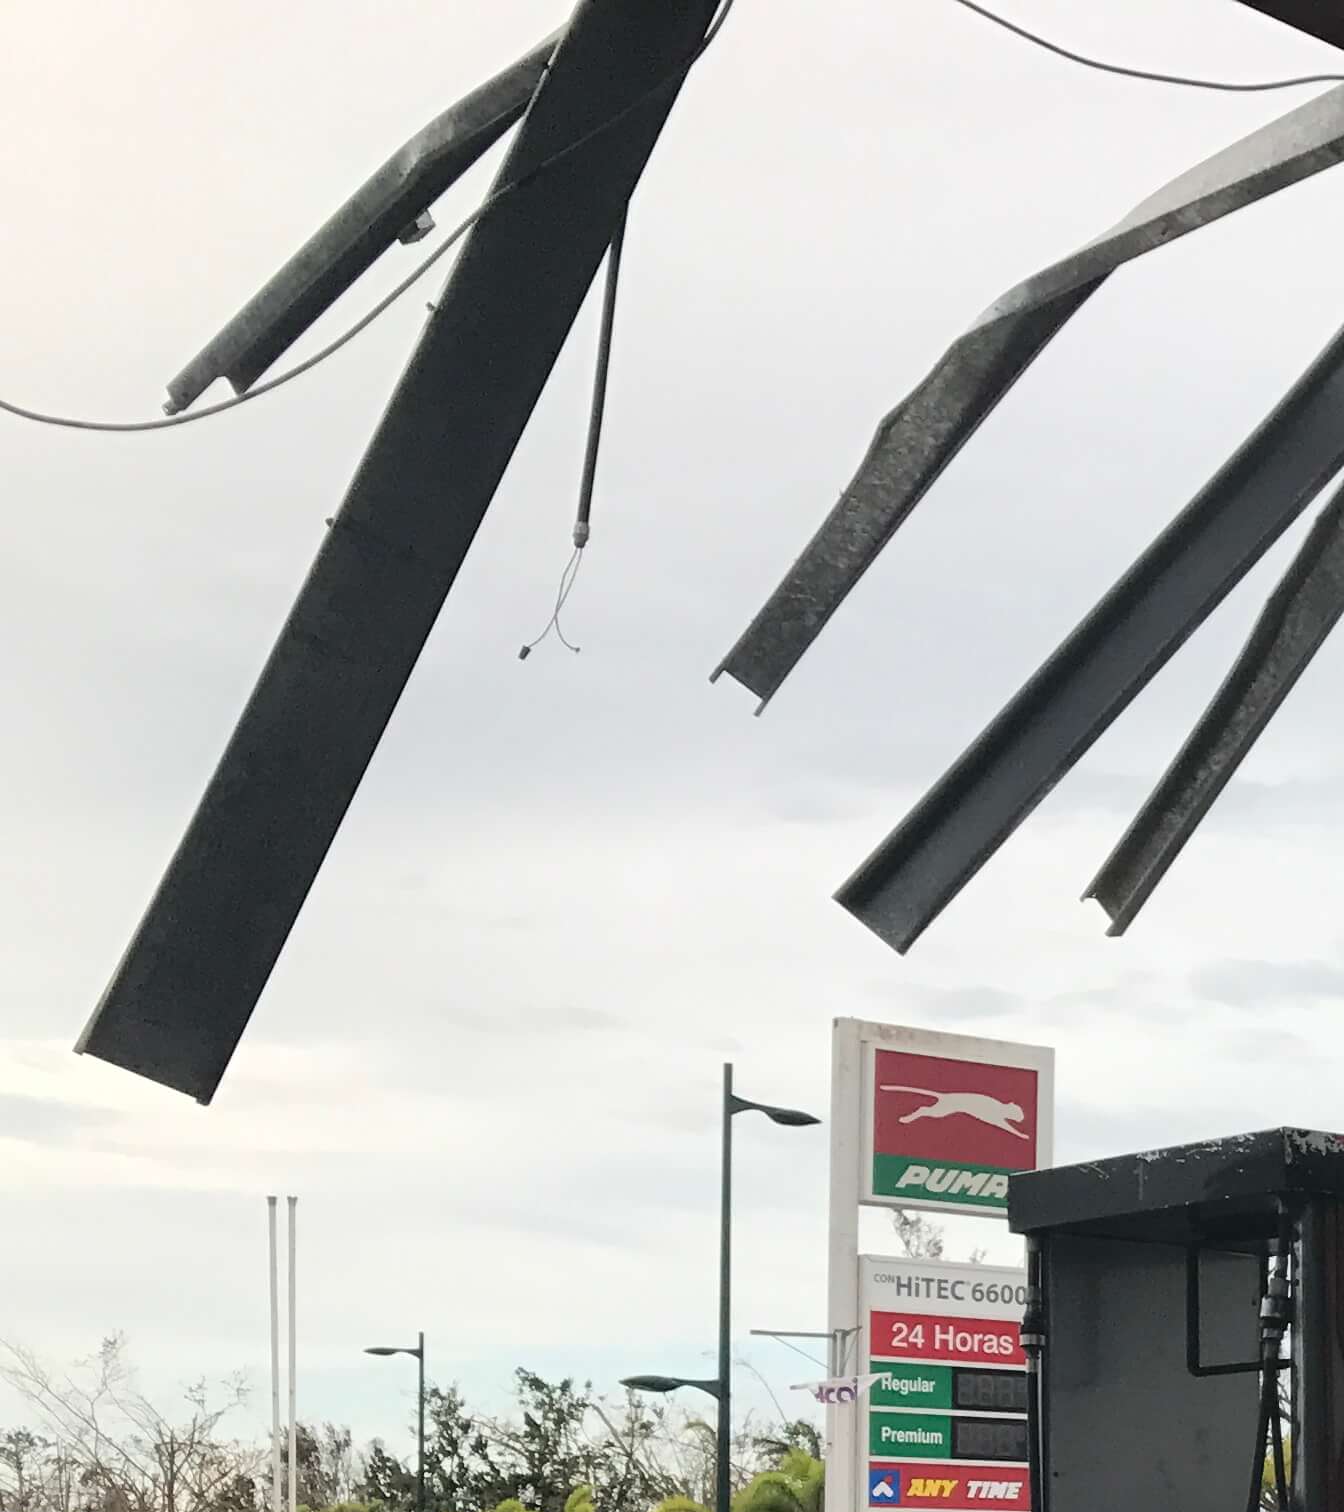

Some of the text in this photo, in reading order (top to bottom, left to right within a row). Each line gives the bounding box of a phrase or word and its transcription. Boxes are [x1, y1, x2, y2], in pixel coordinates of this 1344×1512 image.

[896, 1164, 1009, 1199] PUMA
[873, 1273, 1028, 1306] CON HiTEC 6600
[891, 1322, 1014, 1356] 24 Horas
[881, 1375, 936, 1397] Regular
[881, 1426, 943, 1445] Premium
[906, 1478, 1023, 1500] ANY TIME
